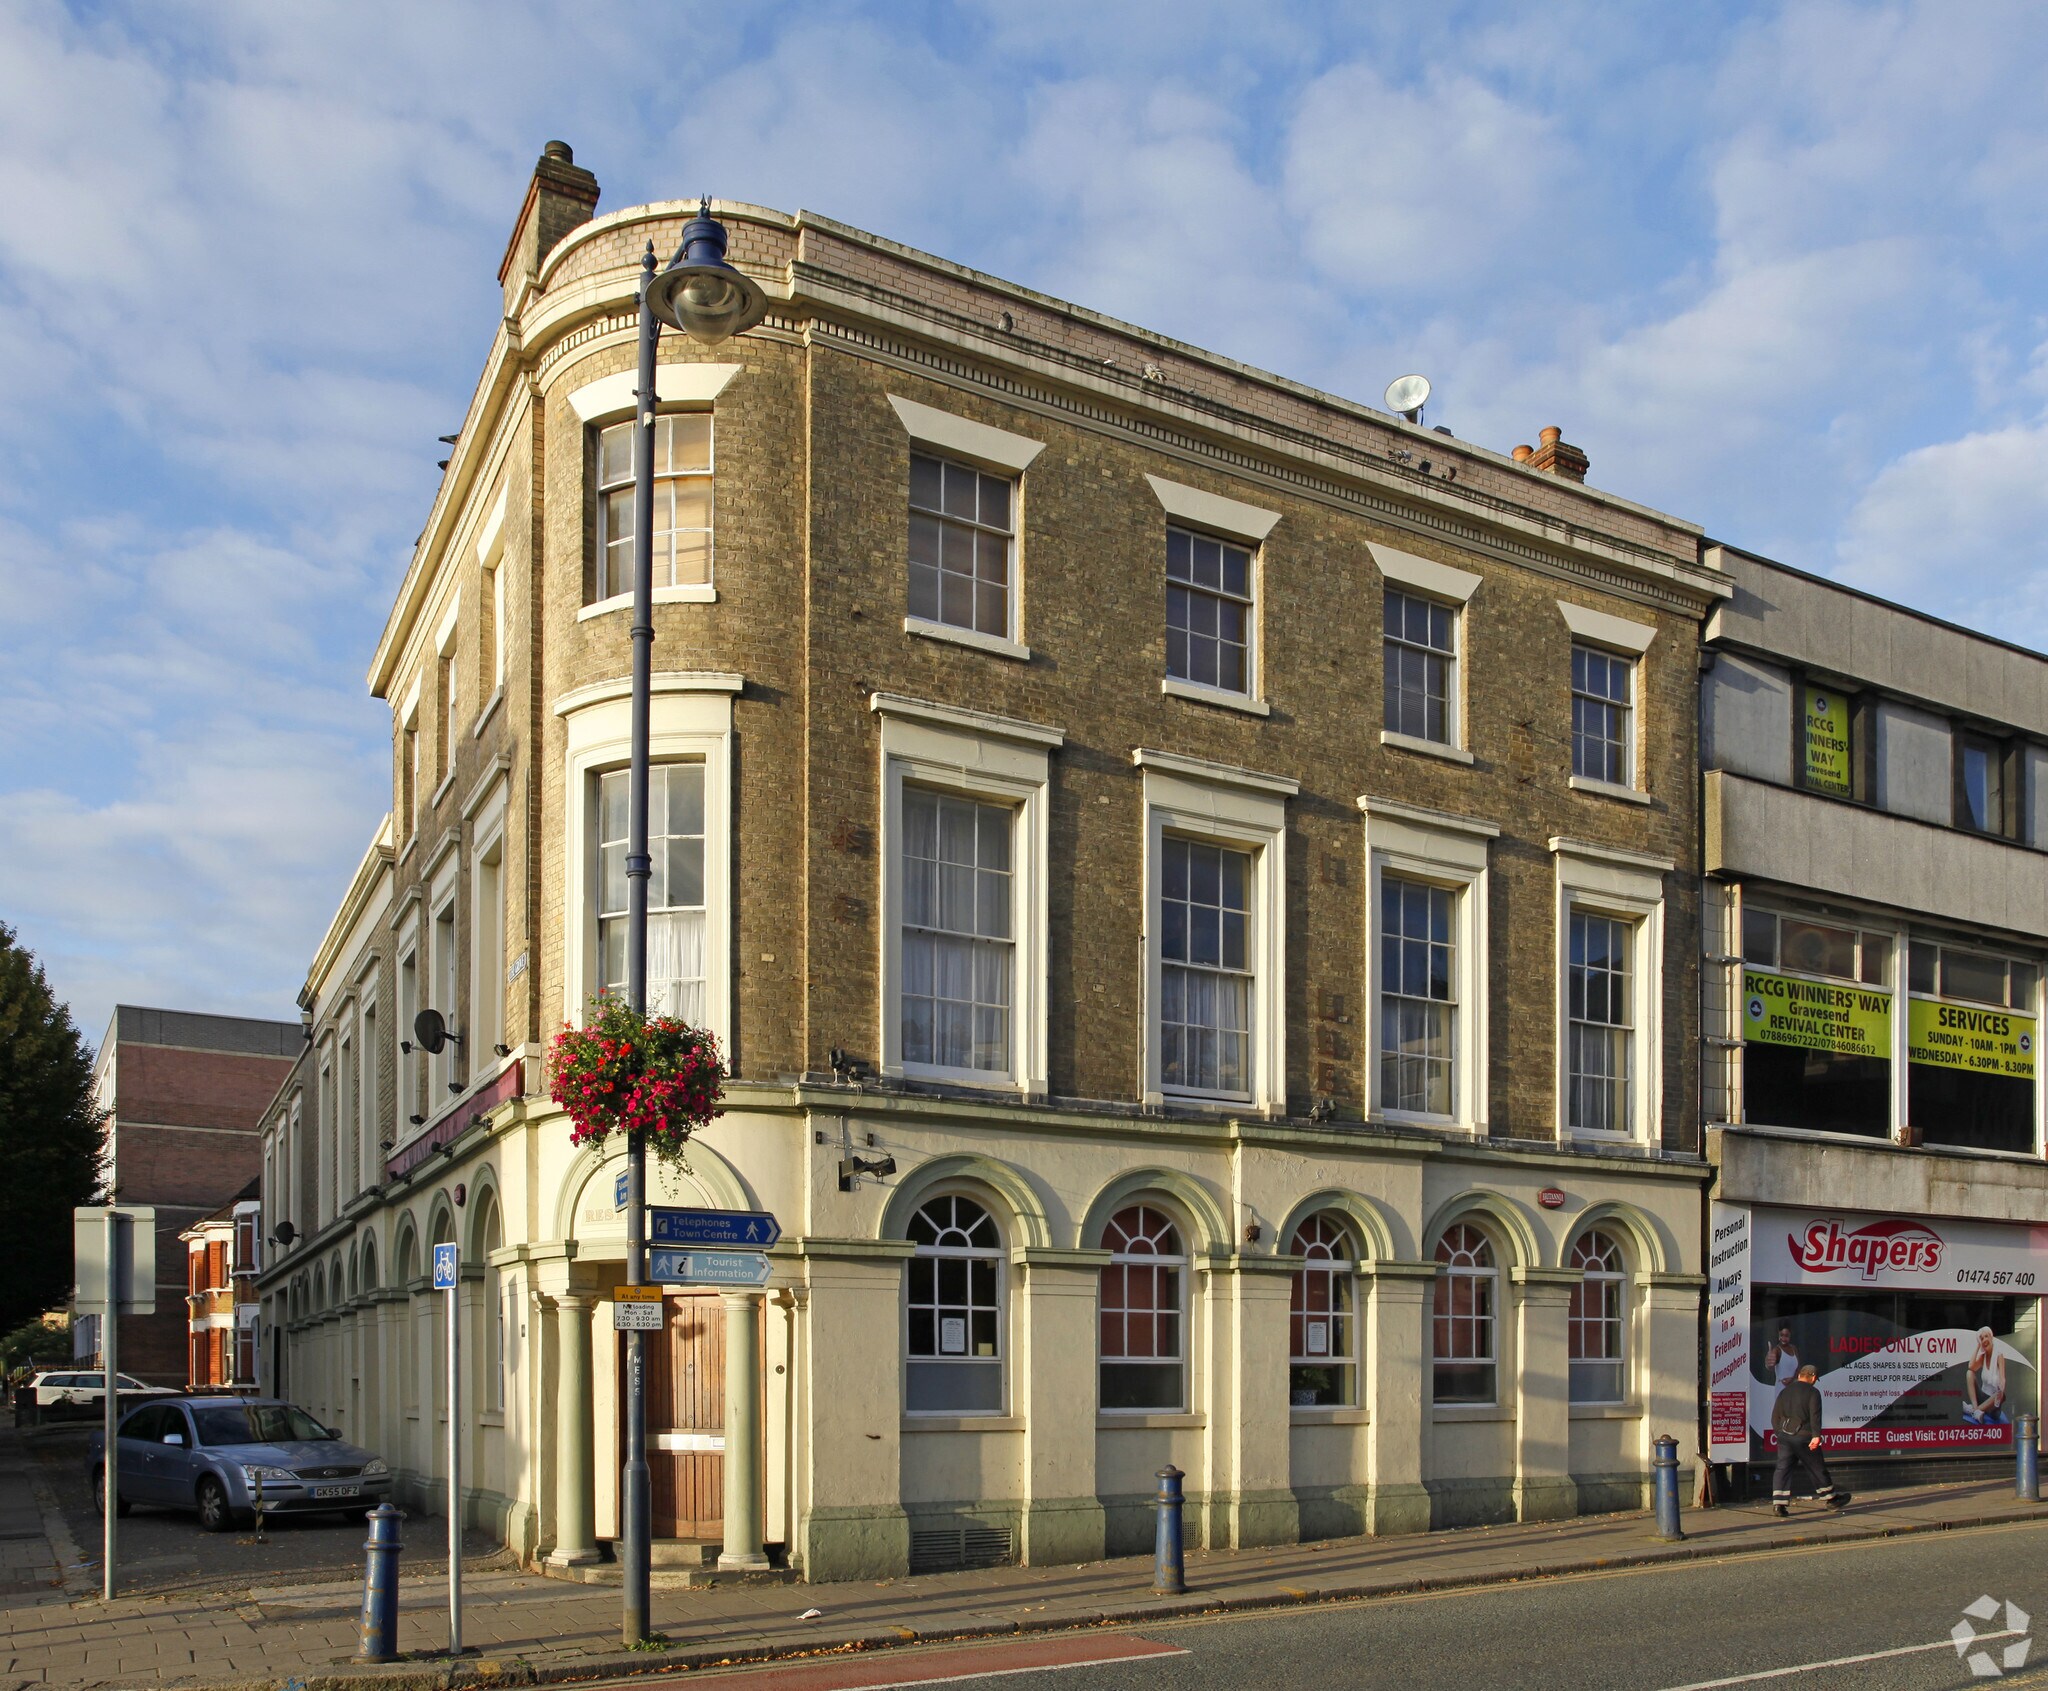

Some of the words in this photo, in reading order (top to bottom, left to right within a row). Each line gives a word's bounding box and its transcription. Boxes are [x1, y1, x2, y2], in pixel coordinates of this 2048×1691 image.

[1807, 715, 1834, 733] RCCG
[1806, 732, 1847, 753] INNERS'
[1810, 750, 1835, 767] WAY
[1745, 975, 1784, 998] RCCG
[1787, 982, 1857, 1009] WINNERS'
[1858, 994, 1890, 1014] WAY
[1790, 1002, 1850, 1023] Gravesend
[1938, 1007, 2010, 1037] SERVICES
[1770, 1015, 1820, 1035] REVIVAL
[1822, 1023, 1865, 1041] CENTER
[1928, 1031, 1964, 1048] SUNDAY
[1970, 1038, 1993, 1052] 10AM
[2000, 1043, 2017, 1055] 1PM
[1908, 1046, 1963, 1065] WEDNESDAY
[1969, 1056, 1999, 1070] 6.30PM
[2006, 1061, 2034, 1075] 8.30PM
[672, 1216, 731, 1228] Telephones
[1714, 1214, 1745, 1243] Personal
[673, 1228, 701, 1238] Town
[702, 1230, 738, 1240] Centre
[1712, 1238, 1748, 1269] Instruction
[1804, 1221, 1941, 1277] Shapers
[706, 1256, 743, 1267] Tourist
[694, 1268, 754, 1279] information
[1718, 1268, 1742, 1294] Always
[1957, 1269, 1990, 1284] 01474
[1992, 1271, 2013, 1285] 567
[2015, 1272, 2035, 1286] 400
[1714, 1288, 1744, 1320] Included
[1721, 1318, 1729, 1333] in
[1730, 1315, 1735, 1327] a
[1714, 1331, 1743, 1360] Friendly
[1830, 1336, 1882, 1353] LADIES
[1886, 1338, 1923, 1353] ONLY
[1927, 1338, 1957, 1354] GYM
[1712, 1352, 1747, 1388] Atmosphere
[1854, 1362, 1871, 1370] AGES,
[1834, 1390, 1862, 1398] specialise
[1870, 1390, 1888, 1398] weight
[1712, 1418, 1729, 1426] weight
[1820, 1434, 1828, 1444] or
[1831, 1434, 1851, 1446] your
[1854, 1432, 1880, 1443] FREE
[1886, 1430, 1913, 1443] Guest
[1914, 1430, 1937, 1442] Visit:
[1939, 1428, 2002, 1441] 01474-567-400
[316, 1488, 340, 1497] GK55
[342, 1487, 358, 1495] OFZ
